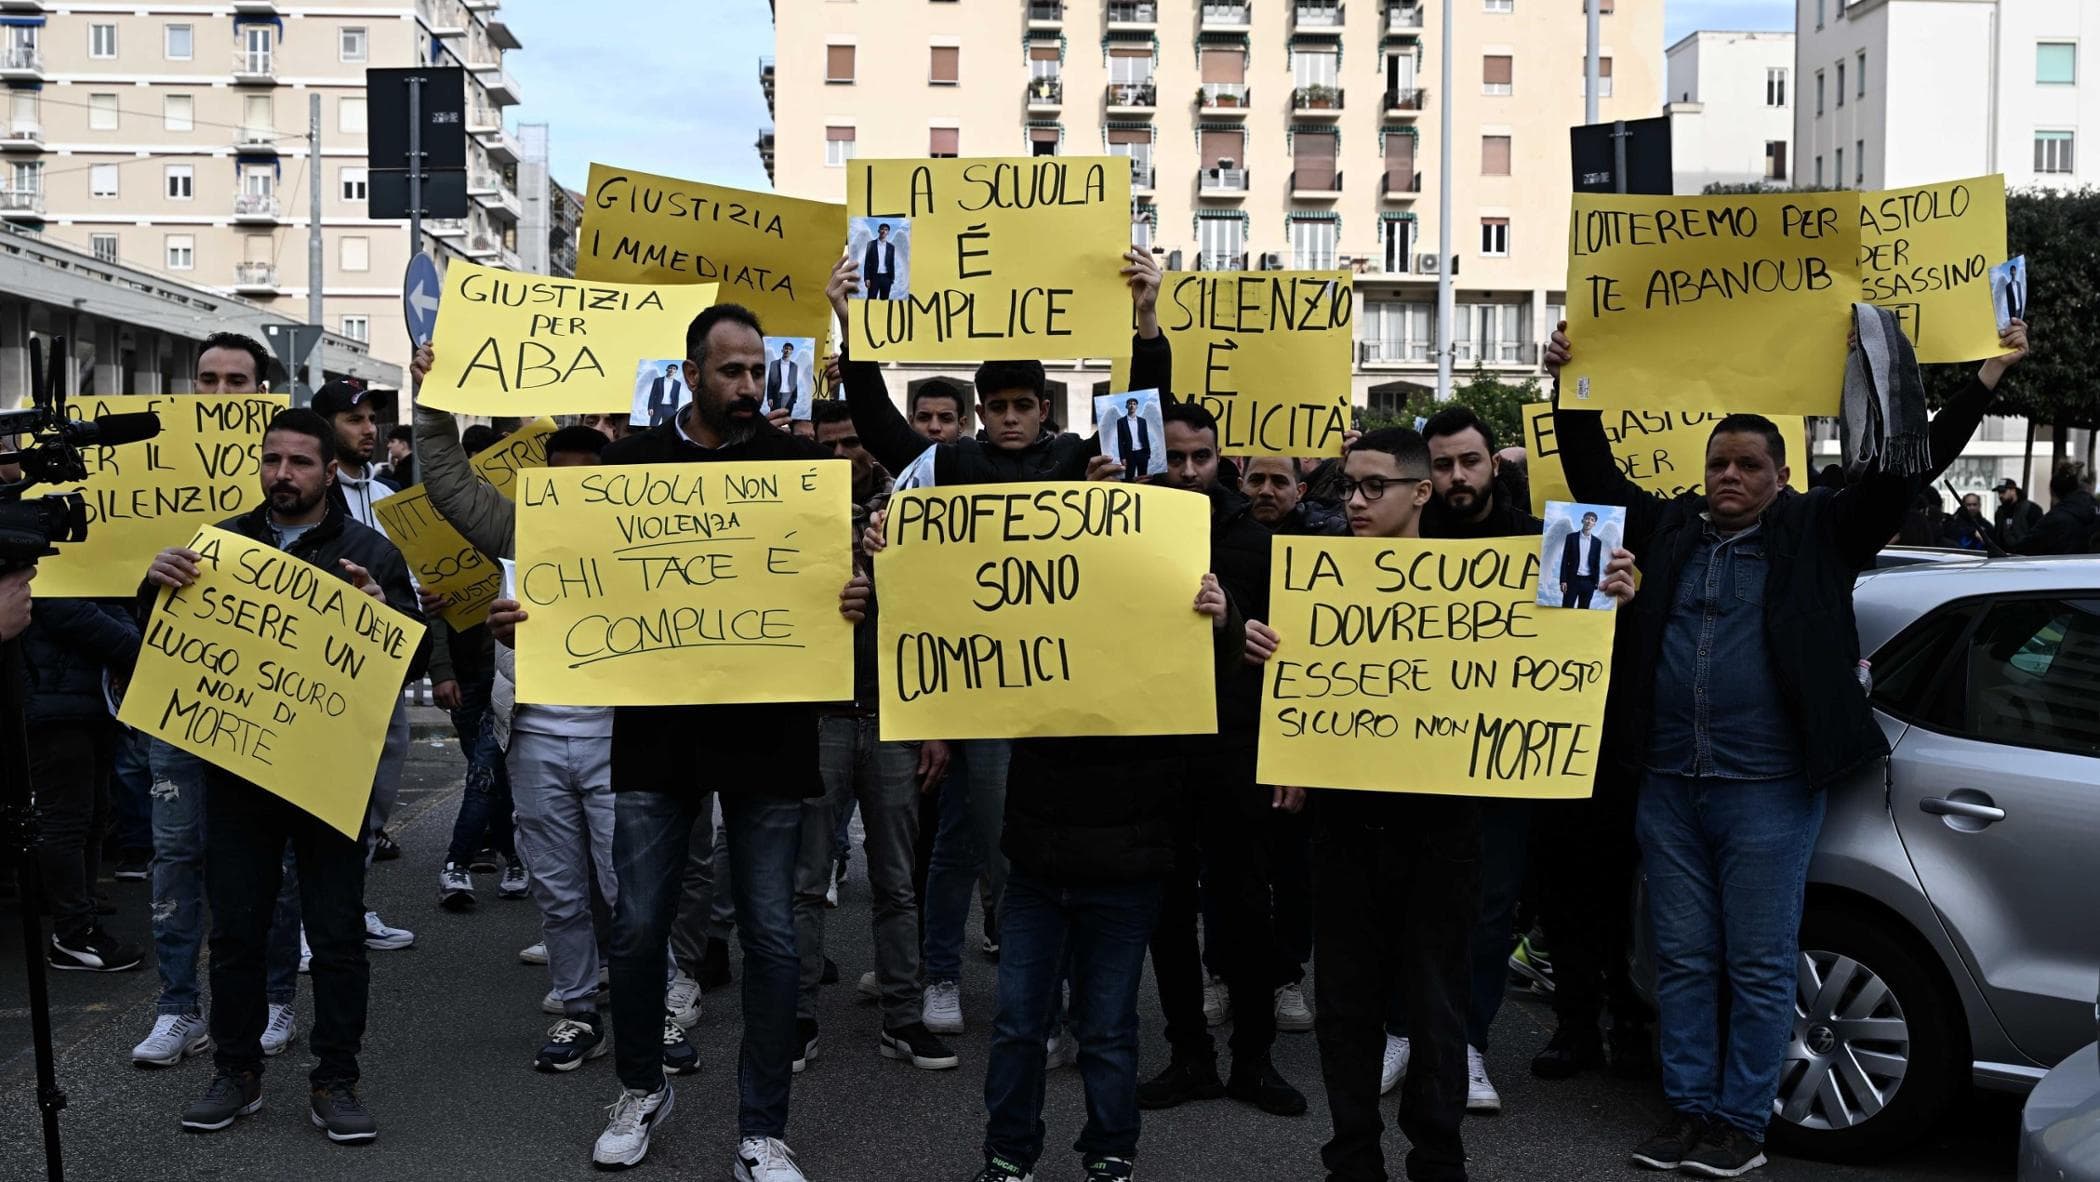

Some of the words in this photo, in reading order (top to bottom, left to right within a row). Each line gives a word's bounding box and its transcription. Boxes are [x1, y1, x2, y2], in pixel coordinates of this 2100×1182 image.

[596, 176, 784, 239] GIUSTIZIA
[867, 165, 934, 218] LA
[957, 161, 1105, 211] SCUOLA
[1860, 185, 1970, 236] ASTOLO
[957, 222, 992, 279] É
[1574, 206, 1757, 256] LOTTEREMO
[1782, 204, 1839, 239] PER
[460, 274, 664, 311] GIUSTIZIA
[592, 229, 796, 301] IMMEDIATA
[1585, 274, 1625, 318] TE
[1645, 256, 1833, 309] ABANOUB
[1862, 254, 1986, 301] SSASSINO
[530, 314, 587, 337] PER
[864, 287, 1074, 350] COMPLICE
[1171, 276, 1353, 333] SILENZIO
[457, 337, 605, 392] ABA
[1205, 338, 1238, 396] È
[1169, 393, 1348, 451] PLICITÀ
[80, 445, 119, 476] ER
[146, 443, 176, 471] IL
[195, 442, 262, 480] VOS
[525, 477, 559, 506] LA
[582, 472, 705, 506] SCUOLA
[726, 474, 778, 500] NON
[801, 468, 818, 491] É
[72, 486, 242, 524] SILENZIO
[617, 512, 740, 544] VIOLENZA
[897, 487, 1141, 546] PROFESSORI
[421, 547, 483, 584] SOG
[523, 558, 604, 605] CHI
[618, 554, 738, 591] TACE
[767, 531, 800, 574] É
[973, 554, 1080, 612] SONO
[1285, 546, 1343, 592] LA
[1375, 548, 1540, 593] SCUOLA
[232, 548, 346, 626] SCUOLA
[356, 602, 408, 660] DEVE
[565, 607, 795, 657] COMPLICE
[1309, 600, 1538, 647] DOVREBBE
[162, 586, 298, 650] ESSERE
[324, 635, 365, 680] UN
[147, 619, 239, 675] LUOGO
[257, 661, 346, 717] SICURO
[896, 631, 1070, 702] COMPLICI
[1273, 659, 1431, 699] ESSERE
[1451, 660, 1497, 690] UN
[1512, 655, 1604, 692] POSTO
[159, 688, 277, 765] MORTE
[197, 676, 253, 708] NON
[273, 701, 297, 725] DI
[1277, 707, 1398, 739] SICURO
[1415, 714, 1469, 739] NON
[1469, 713, 1592, 781] MORTE
